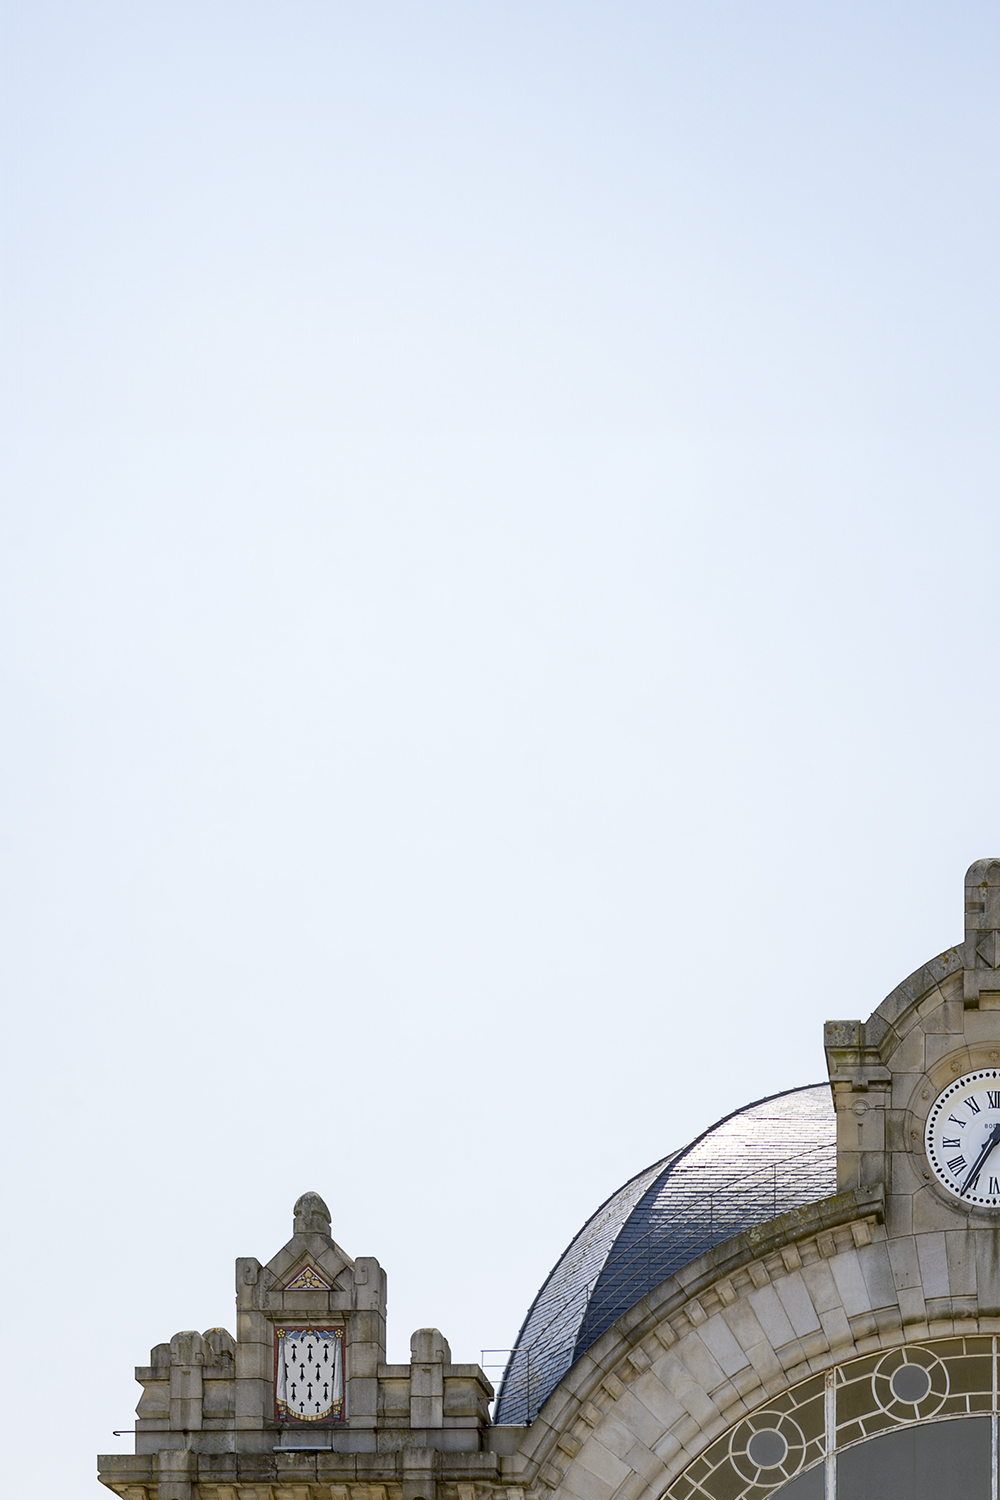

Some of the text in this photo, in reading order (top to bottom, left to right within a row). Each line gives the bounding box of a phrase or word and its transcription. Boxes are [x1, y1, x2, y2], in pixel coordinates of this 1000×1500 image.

[964, 1096, 981, 1115] XI
[987, 1091, 1000, 1108] XII
[949, 1114, 966, 1128] X
[943, 1137, 960, 1148] IX
[947, 1155, 967, 1177] VIII
[989, 1177, 1000, 1194] VI
